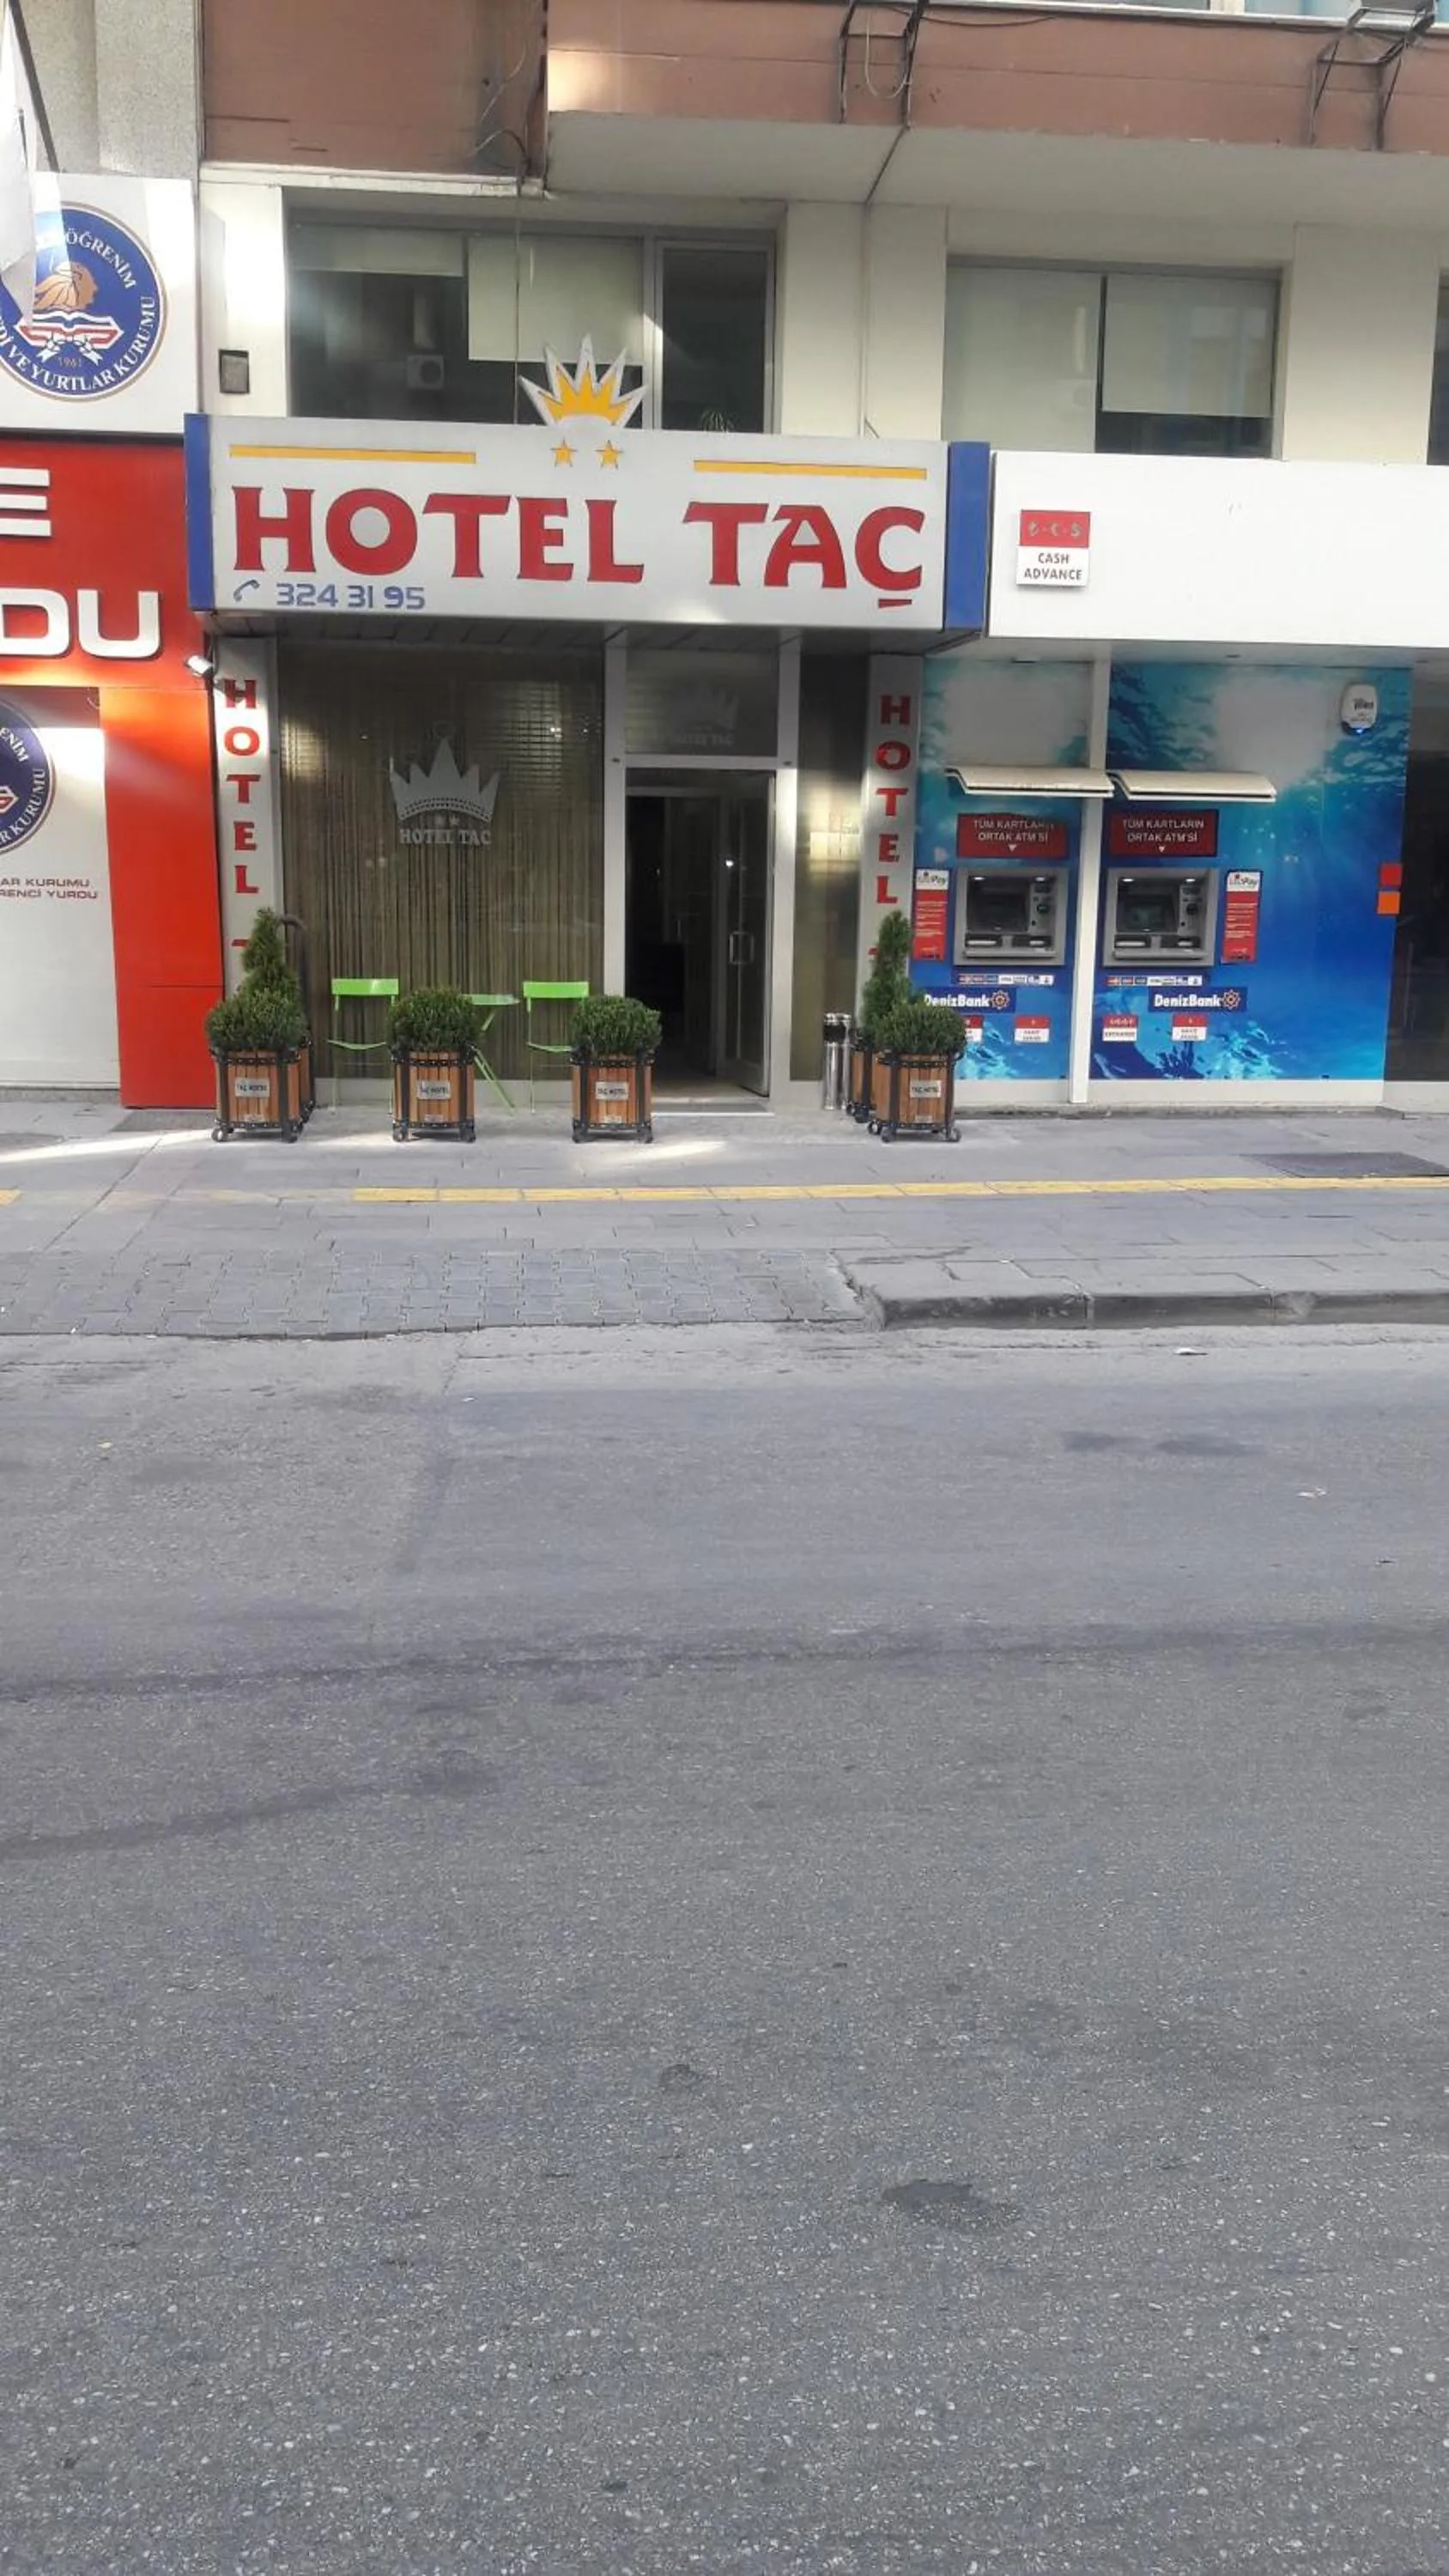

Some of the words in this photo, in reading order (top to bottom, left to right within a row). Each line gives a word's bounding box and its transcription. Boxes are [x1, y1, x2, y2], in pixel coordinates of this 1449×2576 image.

[64, 228, 137, 289] ÖĞRENİM
[8, 344, 33, 371] VE
[31, 363, 115, 392] YURTLAR
[113, 295, 155, 376] KURUMU
[231, 485, 645, 584] HOTEL
[682, 501, 926, 609] TAÇ
[1037, 551, 1071, 565] CASH
[1023, 567, 1083, 581] ADVANCE
[276, 582, 339, 607] 324
[347, 584, 374, 608] 31
[384, 585, 426, 611] 95
[223, 678, 262, 894] HOTEL
[9, 768, 46, 836] KURUMU
[875, 694, 911, 904] HOTEL
[398, 828, 454, 845] HOTEL
[978, 831, 1012, 842] ORTAK
[1127, 831, 1162, 842] ORTAK
[25, 878, 90, 888] KURUMU
[46, 888, 98, 899] YURDU
[923, 993, 991, 1008] DenizBank
[1153, 993, 1222, 1008] DenizBank
